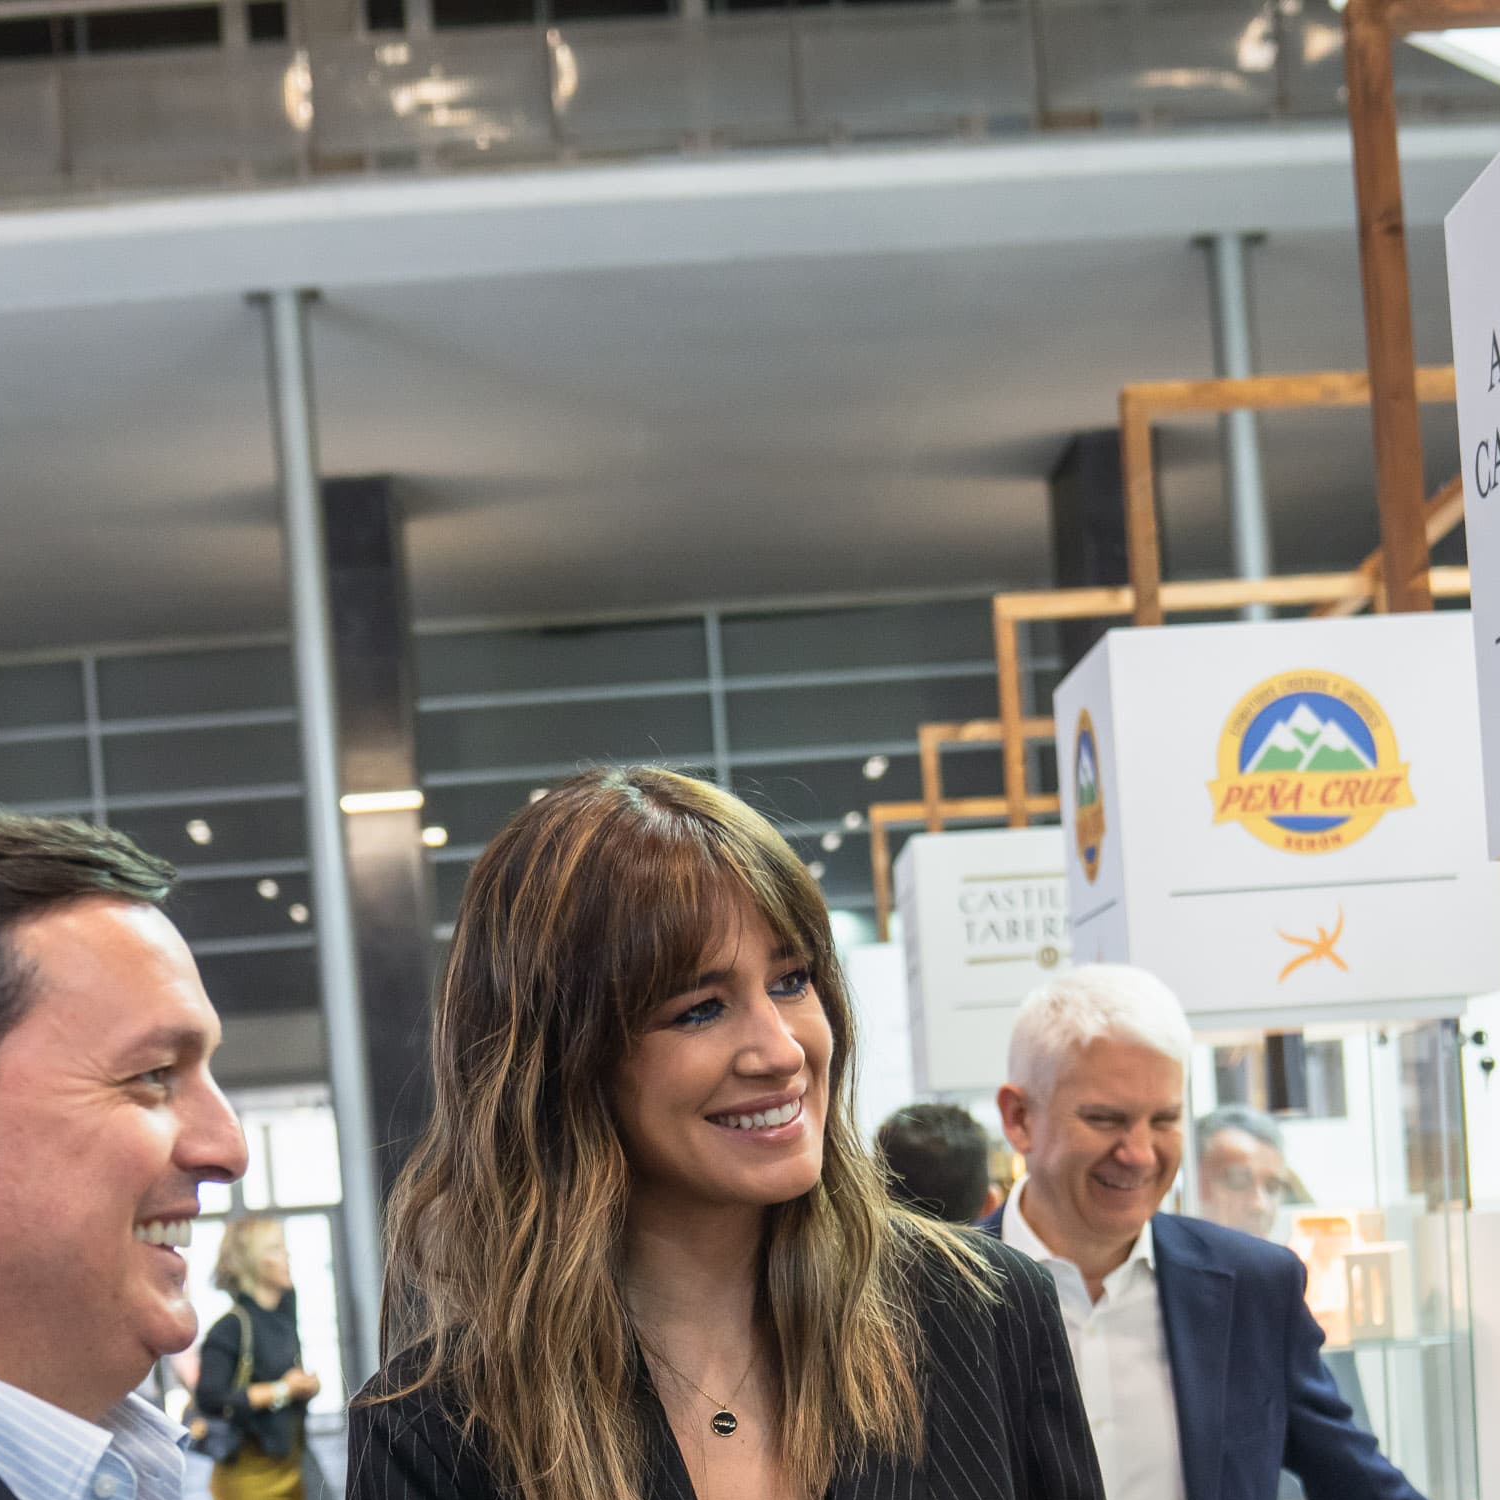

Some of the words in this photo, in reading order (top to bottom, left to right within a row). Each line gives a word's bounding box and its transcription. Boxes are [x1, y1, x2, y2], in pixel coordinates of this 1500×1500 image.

[1220, 778, 1304, 815] PEÑA
[1319, 776, 1406, 809] CRUZ
[957, 887, 1067, 914] CASTIL
